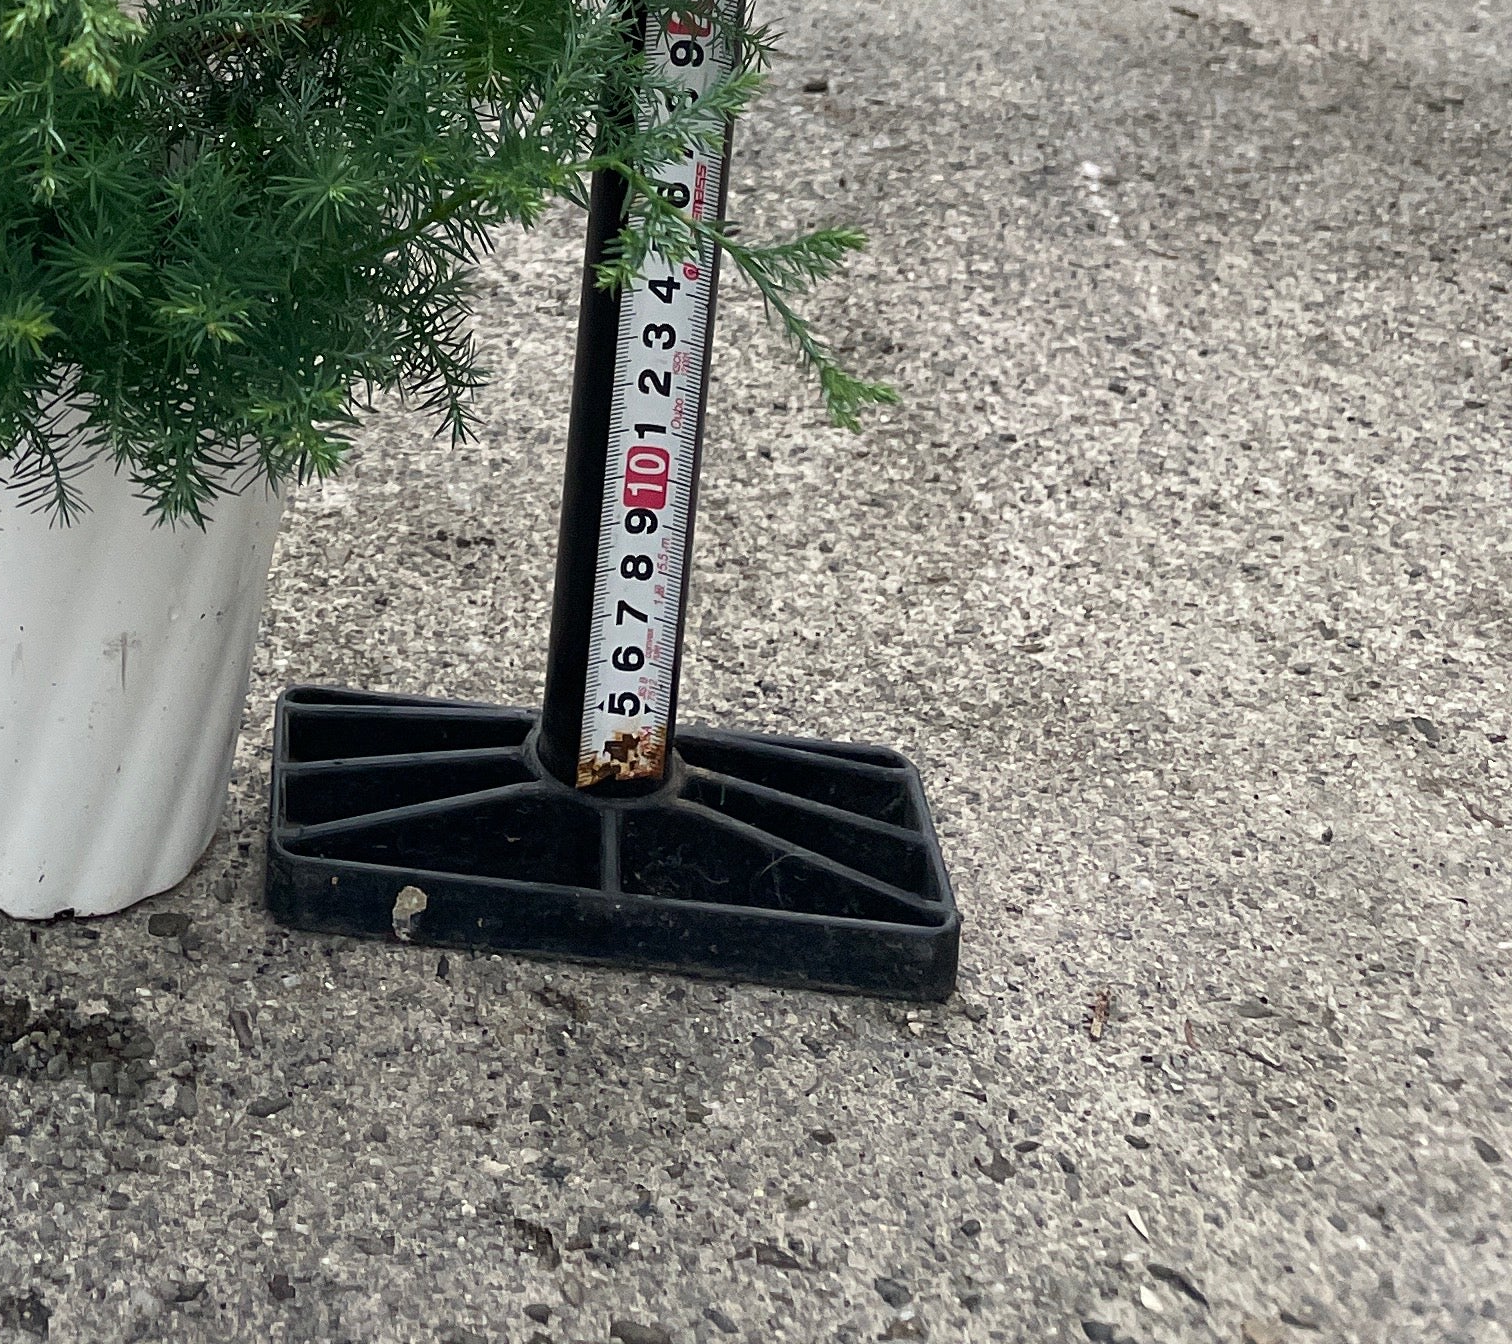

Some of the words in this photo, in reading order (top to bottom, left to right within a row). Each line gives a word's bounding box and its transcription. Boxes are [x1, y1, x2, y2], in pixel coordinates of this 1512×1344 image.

[670, 40, 704, 67] 9
[656, 183, 690, 208] 6
[649, 276, 680, 304] 4
[643, 323, 676, 349] 3
[638, 369, 672, 397] 2
[634, 424, 666, 439] 1
[627, 453, 666, 496] 10
[625, 508, 659, 534] 9
[621, 555, 654, 581] 8
[616, 600, 649, 625] 7
[612, 646, 645, 671] 6
[607, 692, 640, 717] 5
